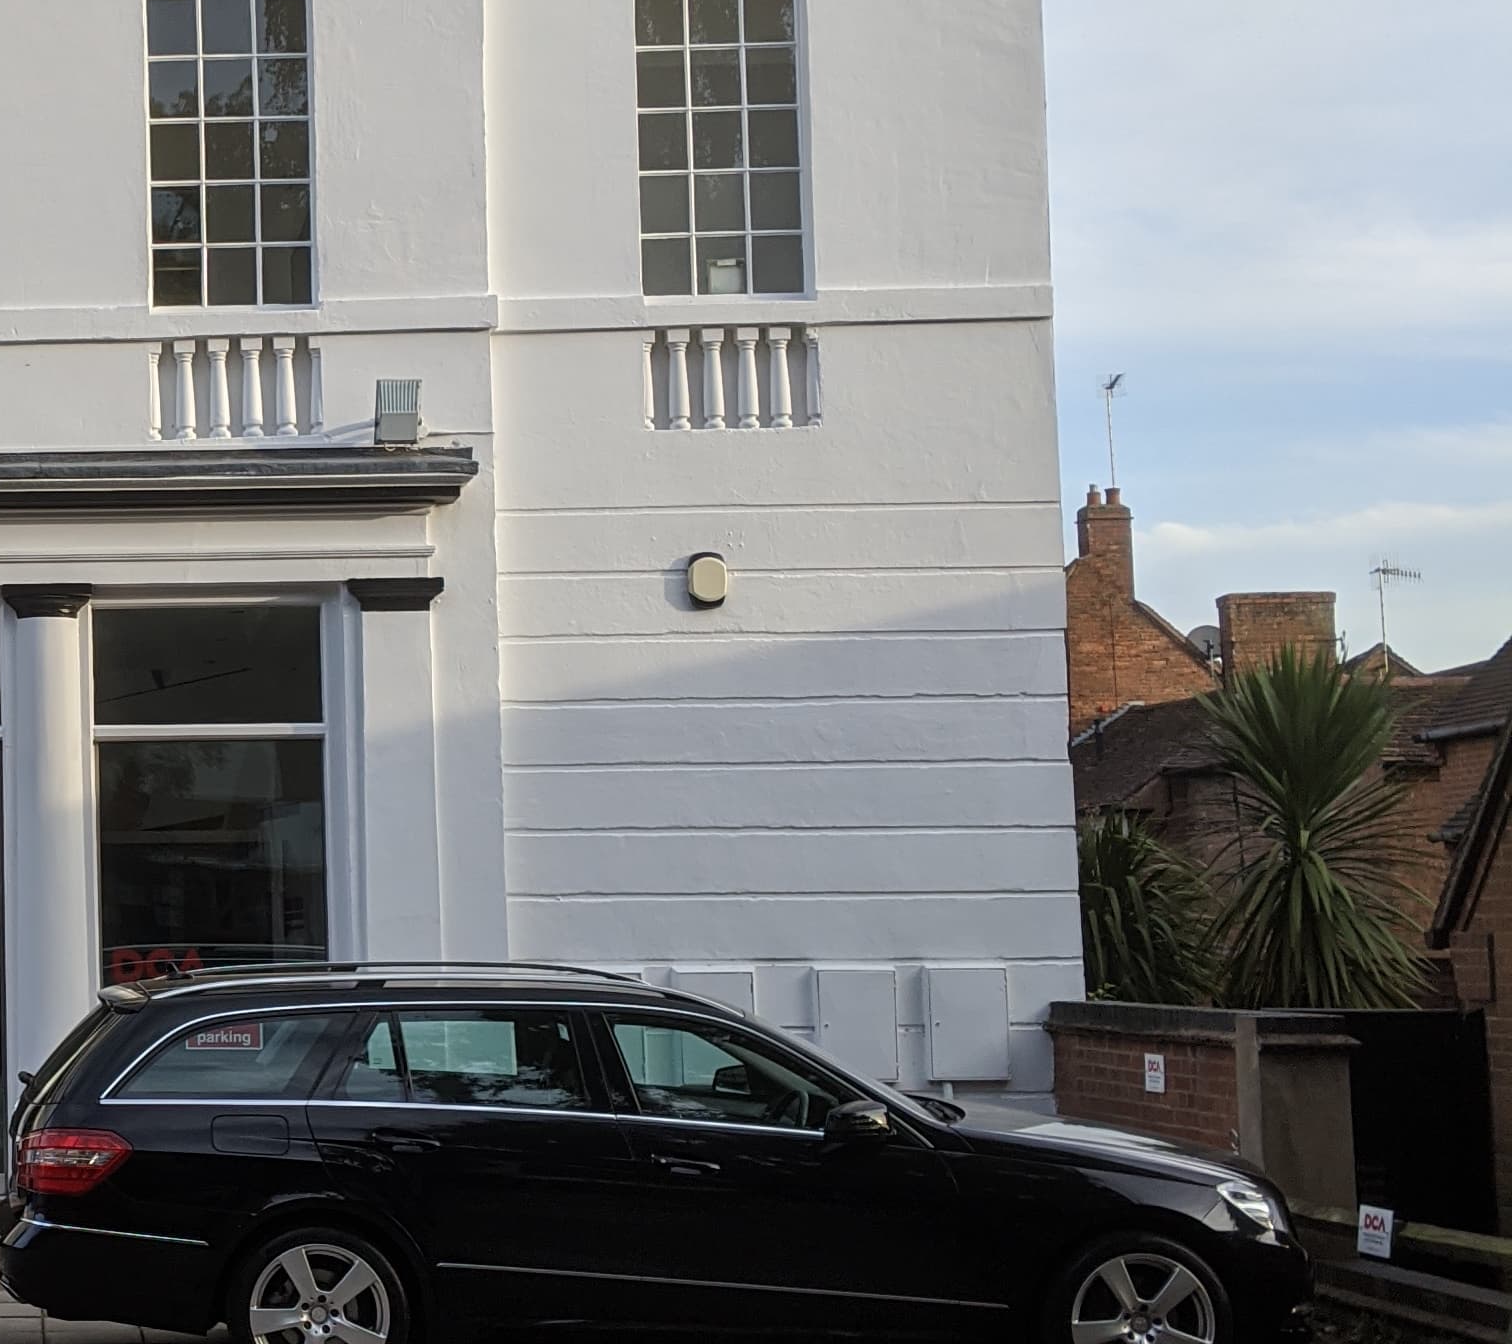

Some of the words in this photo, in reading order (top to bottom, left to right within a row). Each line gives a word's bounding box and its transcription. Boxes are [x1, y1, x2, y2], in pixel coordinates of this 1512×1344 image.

[111, 948, 204, 985] DCA
[197, 1030, 251, 1046] parking
[1364, 1213, 1386, 1233] DCA
